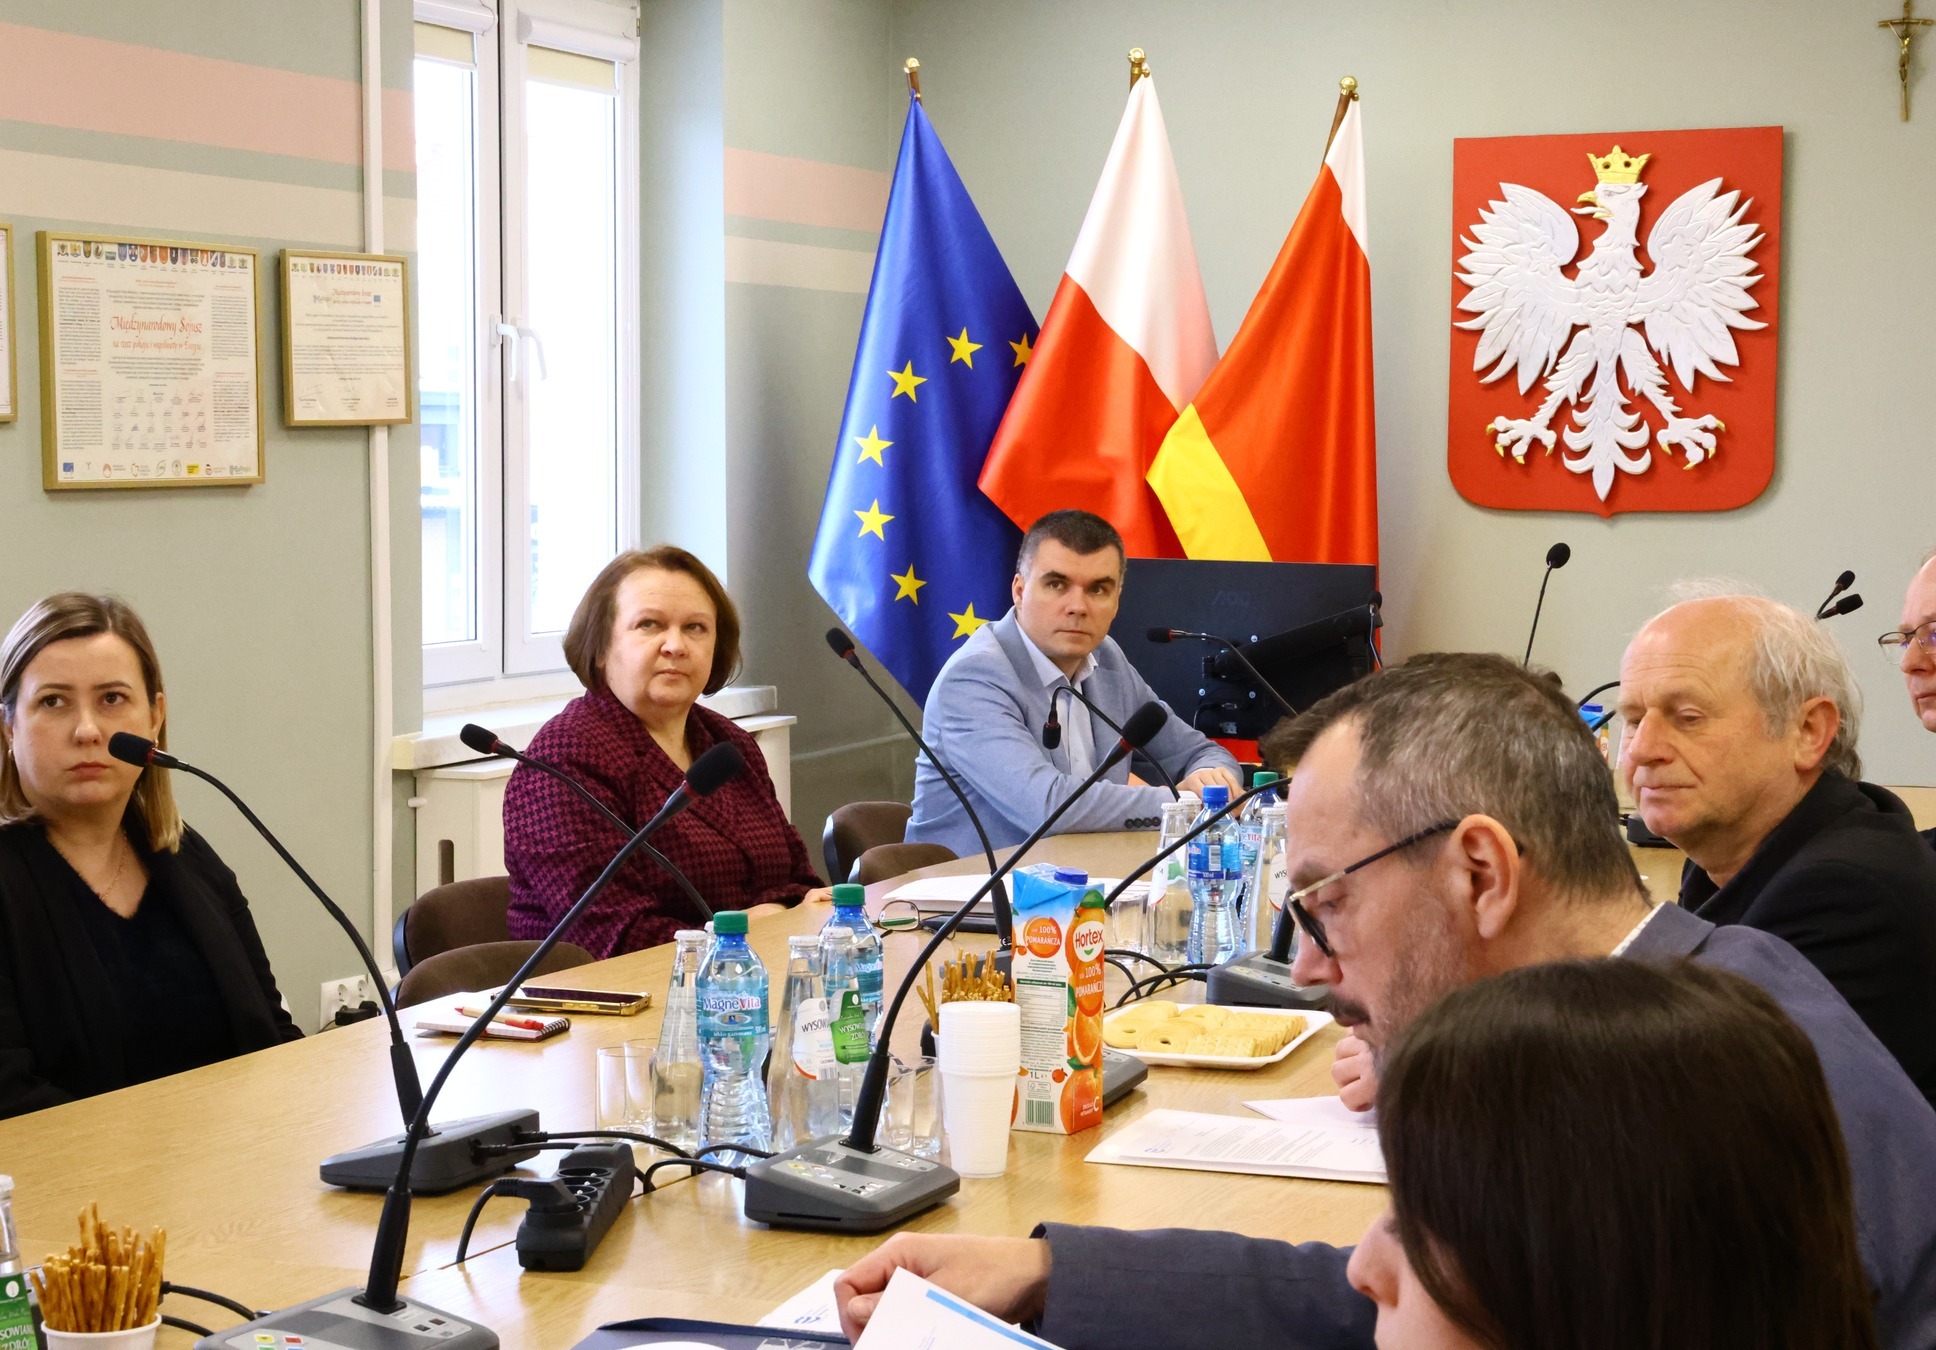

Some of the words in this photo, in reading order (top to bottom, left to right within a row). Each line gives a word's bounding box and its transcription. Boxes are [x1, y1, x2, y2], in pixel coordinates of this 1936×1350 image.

[110, 312, 177, 337] Międzynarodowy
[178, 315, 203, 338] Sojusz
[1039, 925, 1057, 934] 100%
[1026, 935, 1060, 946] POMARAŃCZA
[1075, 928, 1104, 949] Hortex
[1085, 962, 1102, 978] 100%
[702, 995, 761, 1012] MagneVita
